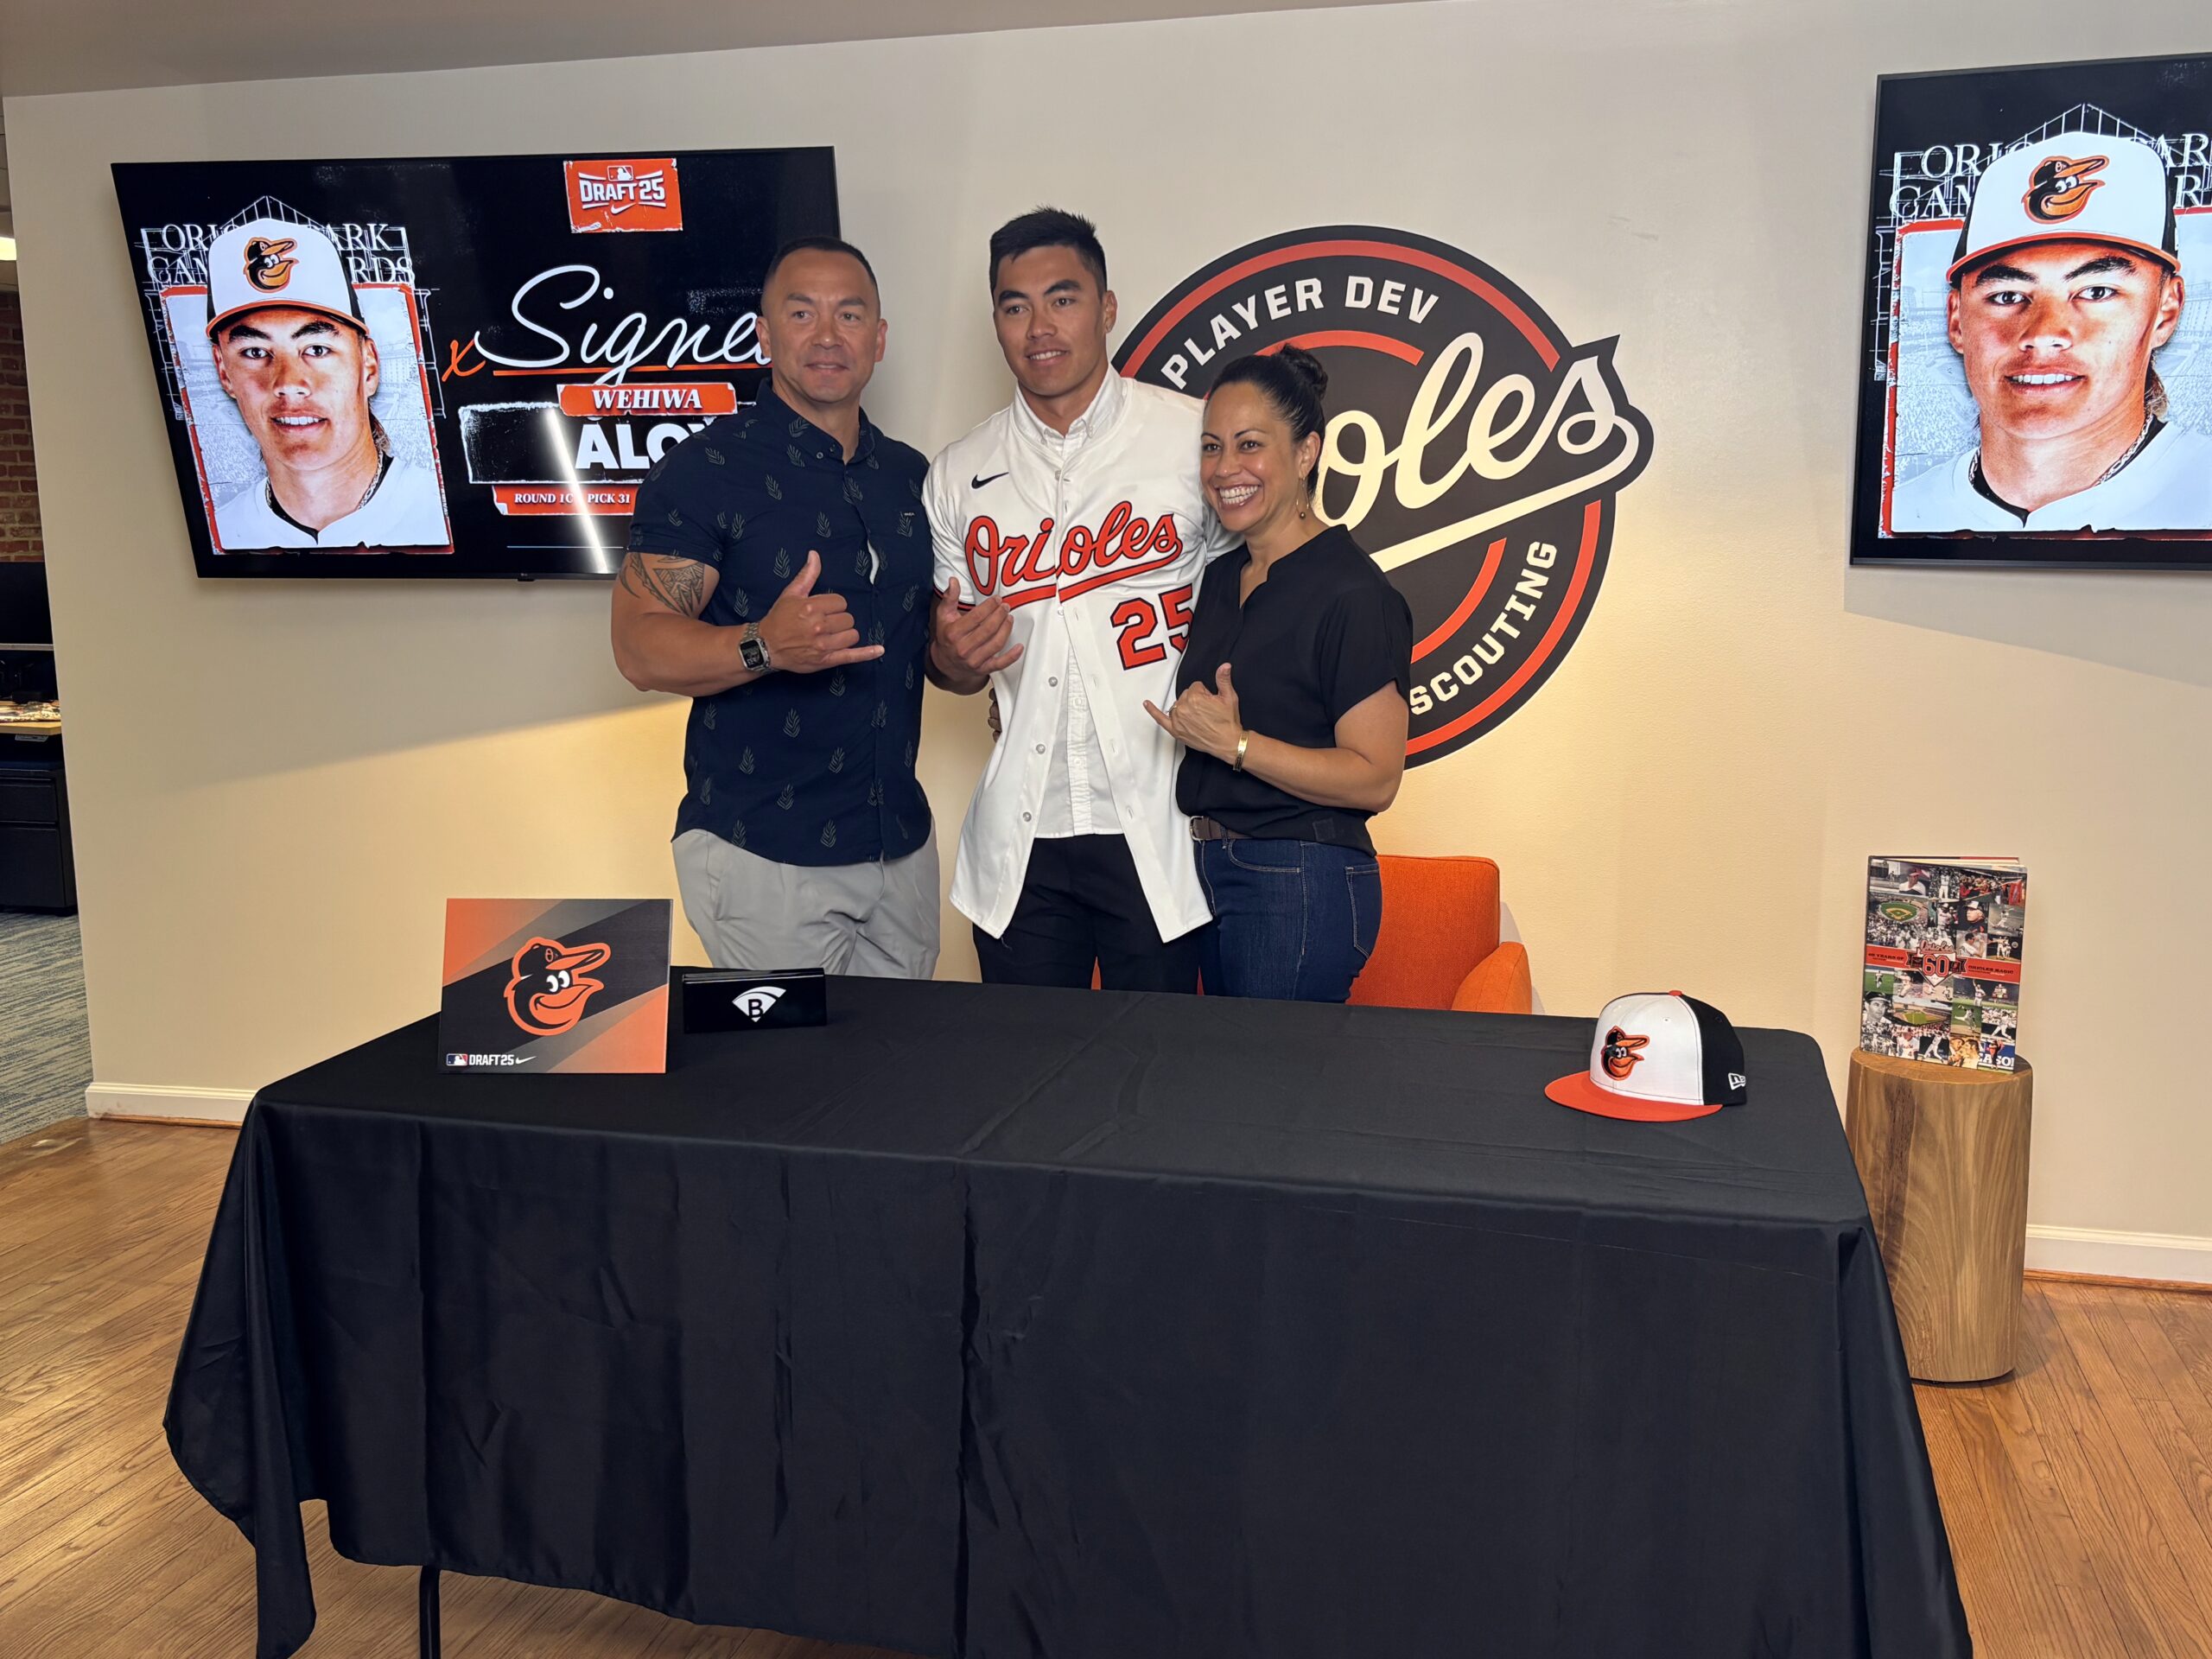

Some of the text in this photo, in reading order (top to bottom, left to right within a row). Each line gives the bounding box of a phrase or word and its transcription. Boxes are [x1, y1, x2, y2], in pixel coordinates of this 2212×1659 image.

[474, 264, 772, 385] Signe
[1160, 276, 1440, 390] PLAYER DEV
[575, 423, 707, 469] ALO
[592, 389, 702, 409] WEHIWA
[514, 493, 556, 504] ROUND
[588, 493, 615, 504] PICK
[618, 493, 630, 504] 31
[1303, 332, 1639, 572] oles
[965, 500, 1183, 610] Orioles
[1110, 583, 1193, 671] 25
[1410, 541, 1557, 715] SCOUTING
[1923, 954, 1950, 977] 60
